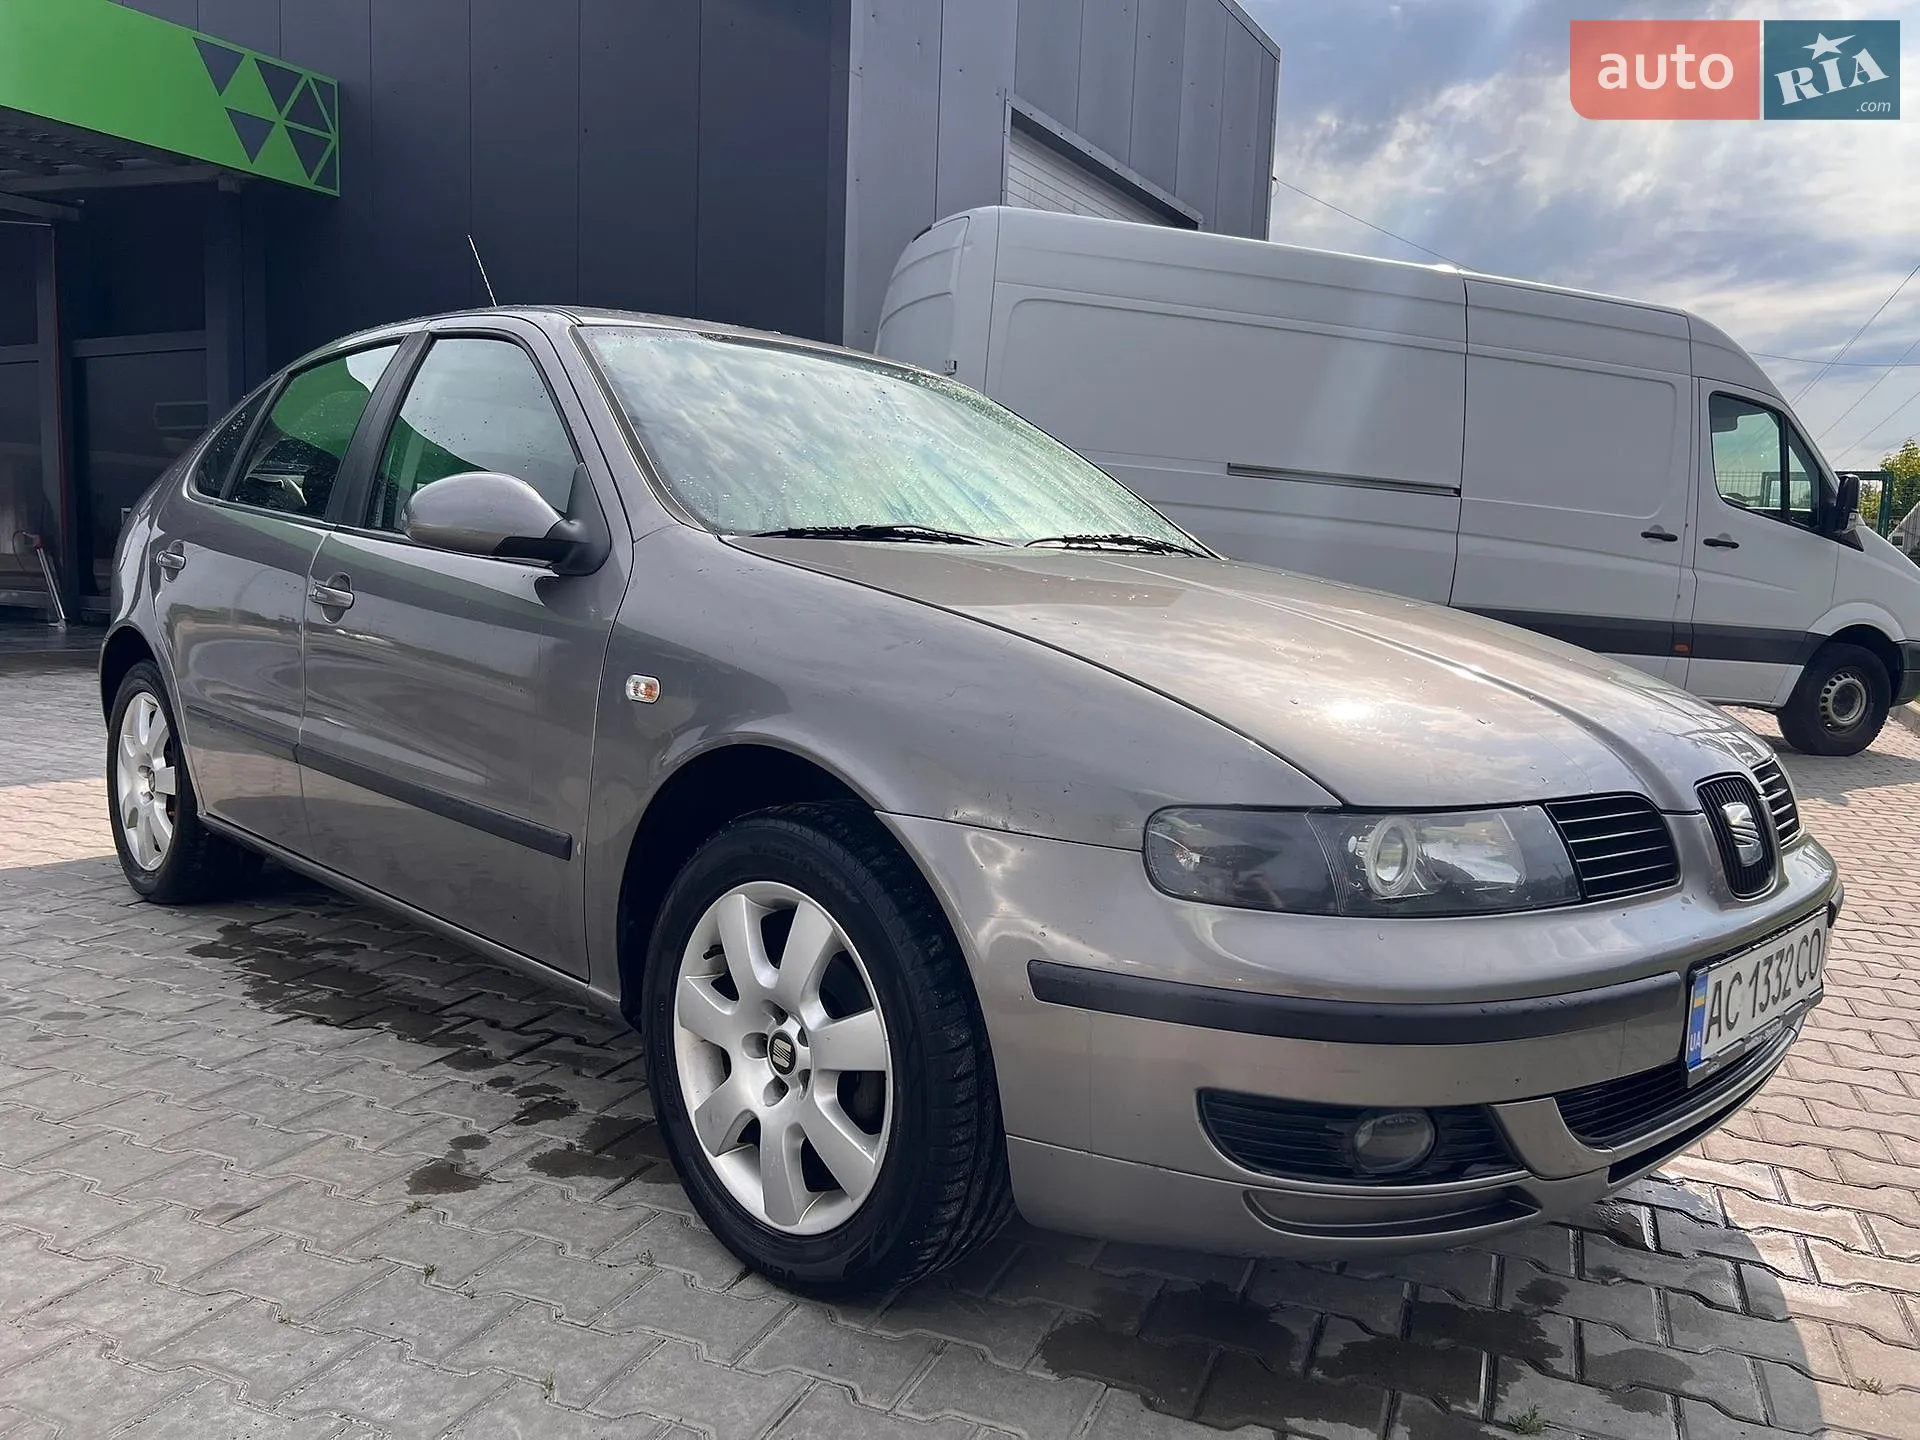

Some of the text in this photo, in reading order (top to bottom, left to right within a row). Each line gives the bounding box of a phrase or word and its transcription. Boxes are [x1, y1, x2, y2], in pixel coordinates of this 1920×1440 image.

[1704, 971, 1743, 1045] AC
[1748, 943, 1795, 1019] 1332
[1689, 1030, 1701, 1052] UA
